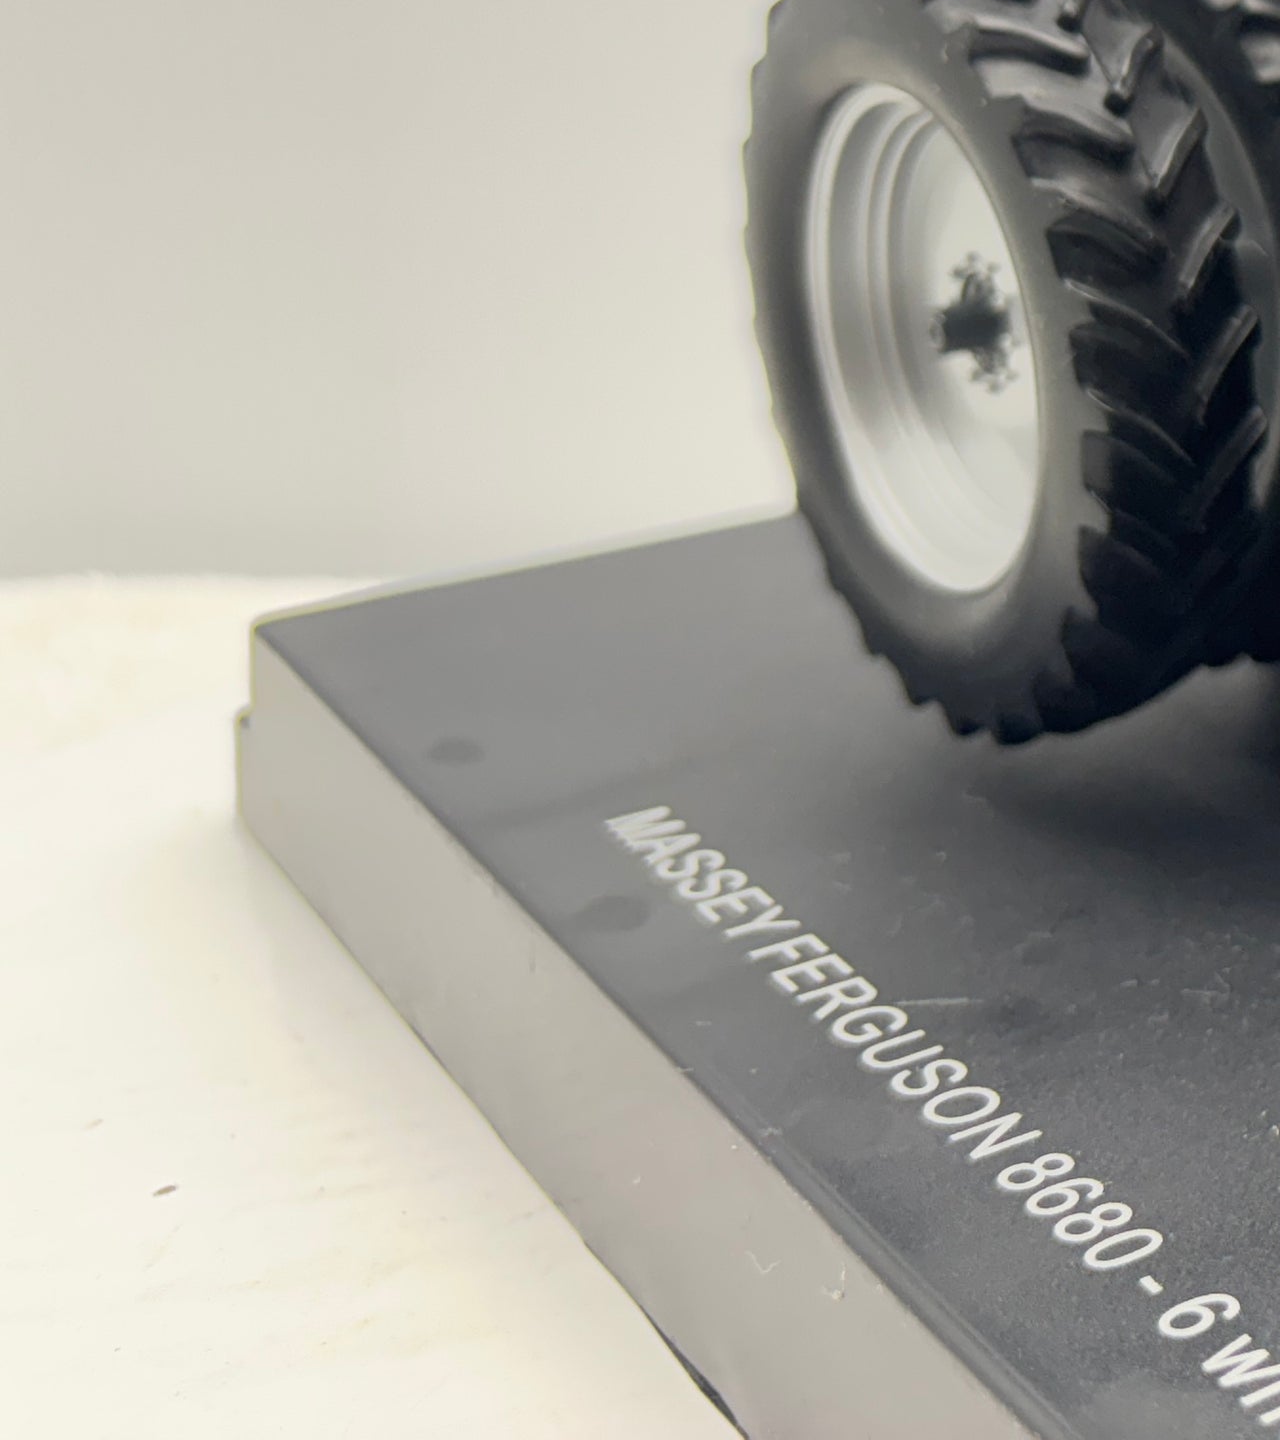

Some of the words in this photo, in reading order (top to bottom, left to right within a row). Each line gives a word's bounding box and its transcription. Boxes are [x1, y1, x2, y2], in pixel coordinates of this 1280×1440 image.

[605, 805, 801, 939] MASSEY
[749, 933, 1042, 1162] FERGUSON
[996, 1152, 1164, 1271] 8680
[1157, 1293, 1241, 1339] 6
